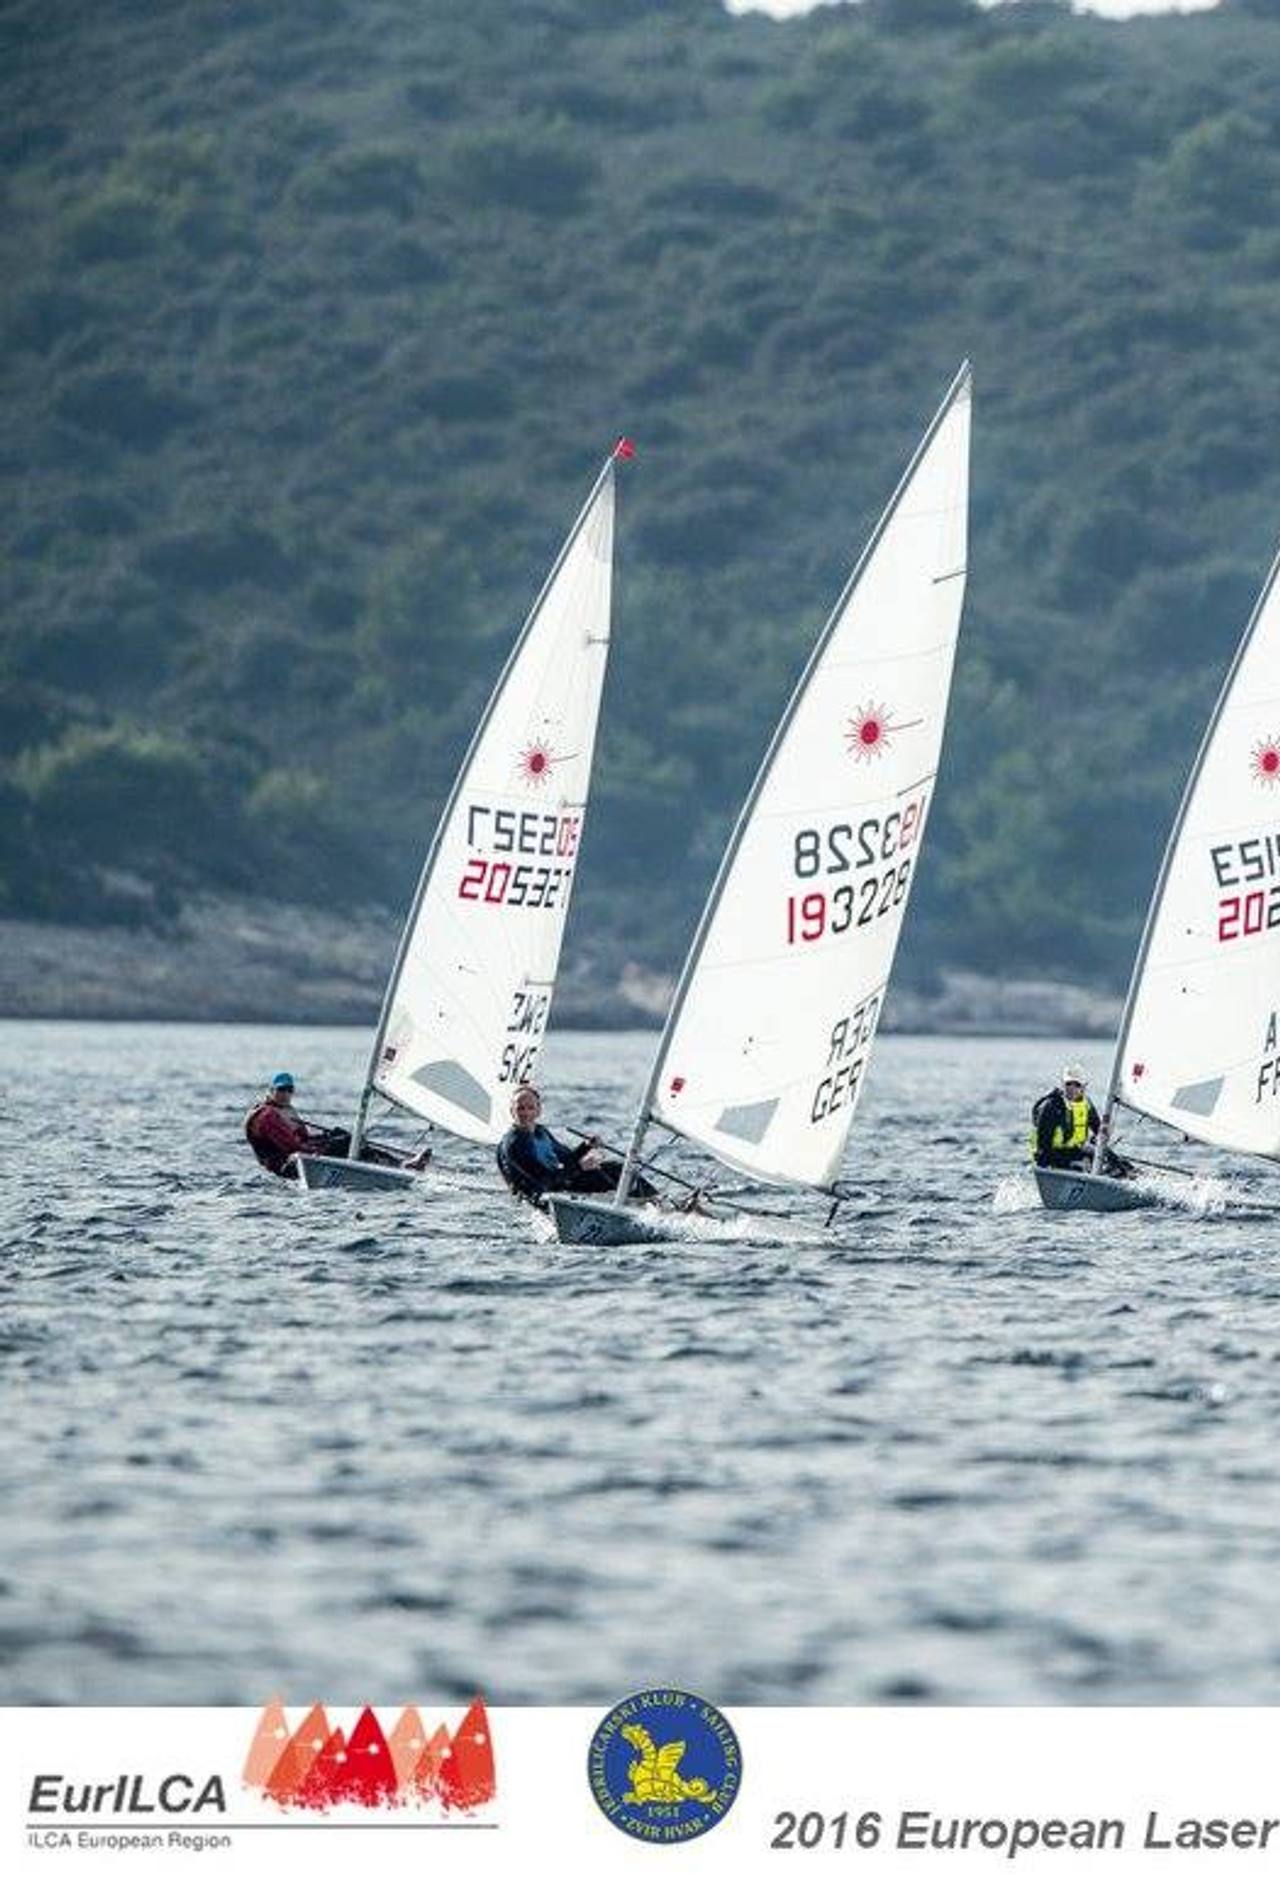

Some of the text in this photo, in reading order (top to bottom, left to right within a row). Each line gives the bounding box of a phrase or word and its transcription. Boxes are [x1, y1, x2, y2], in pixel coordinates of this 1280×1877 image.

[458, 860, 571, 908] 205327
[788, 858, 911, 945] 193228
[811, 1058, 863, 1123] GER
